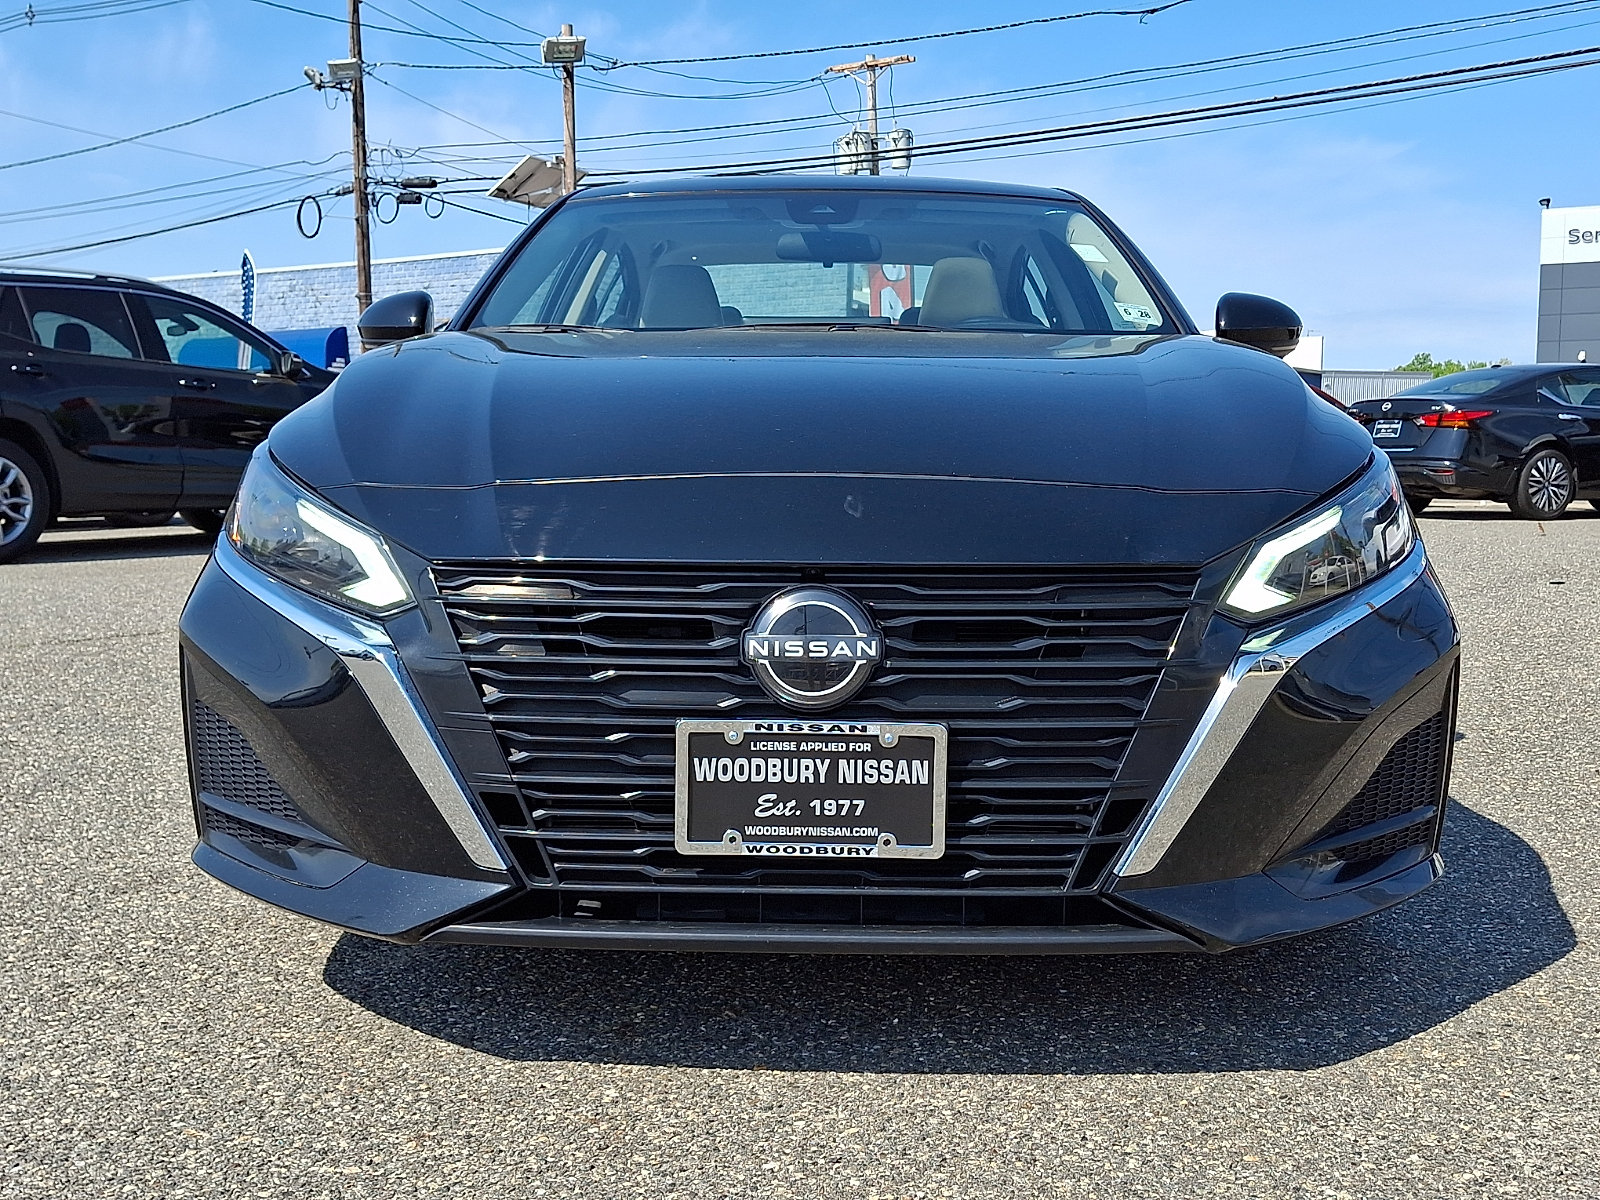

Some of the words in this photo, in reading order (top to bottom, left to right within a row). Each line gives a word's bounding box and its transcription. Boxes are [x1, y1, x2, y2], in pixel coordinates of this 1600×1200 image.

[1138, 310, 1151, 318] 28
[748, 639, 877, 657] NISSAN
[754, 723, 868, 733] NISSAN
[750, 741, 797, 751] LICENSE
[799, 742, 846, 752] APPLIED
[849, 742, 872, 752] FOR
[693, 757, 831, 784] WOODBURY
[837, 758, 929, 785] NISSAN
[754, 793, 801, 818] Est.
[809, 799, 866, 817] 1977
[744, 825, 879, 837] WOODBURYNISSAN.COM
[745, 844, 876, 856] WOODBURY
